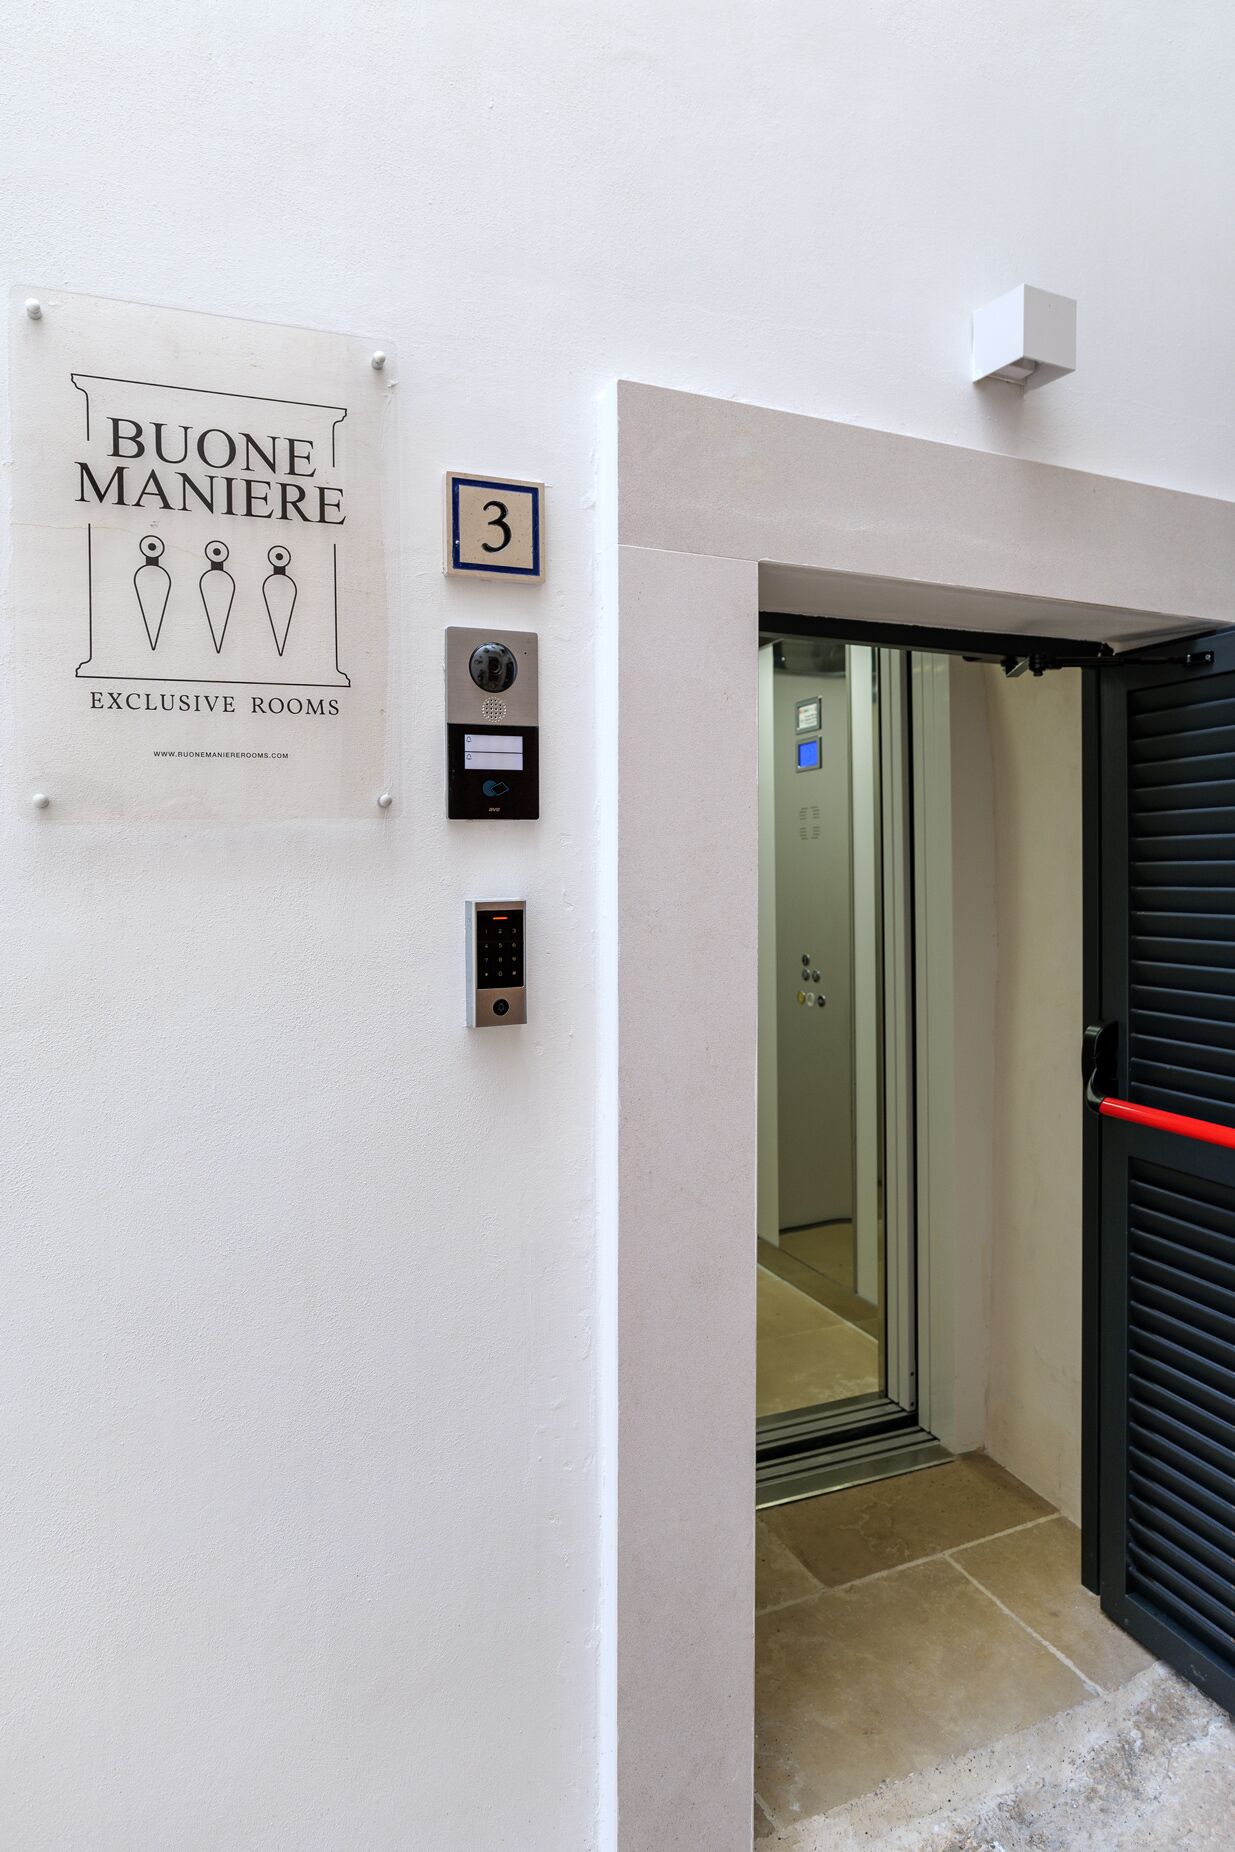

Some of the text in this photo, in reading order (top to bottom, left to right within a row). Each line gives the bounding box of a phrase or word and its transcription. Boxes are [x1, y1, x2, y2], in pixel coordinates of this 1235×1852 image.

[107, 417, 316, 477] BUONE
[75, 462, 346, 526] MANIERE
[482, 501, 511, 552] 3
[90, 691, 340, 716] EXCLUSIVE ROOMS
[153, 751, 289, 759] WWW.BUONEMANIEREROOMS.COM
